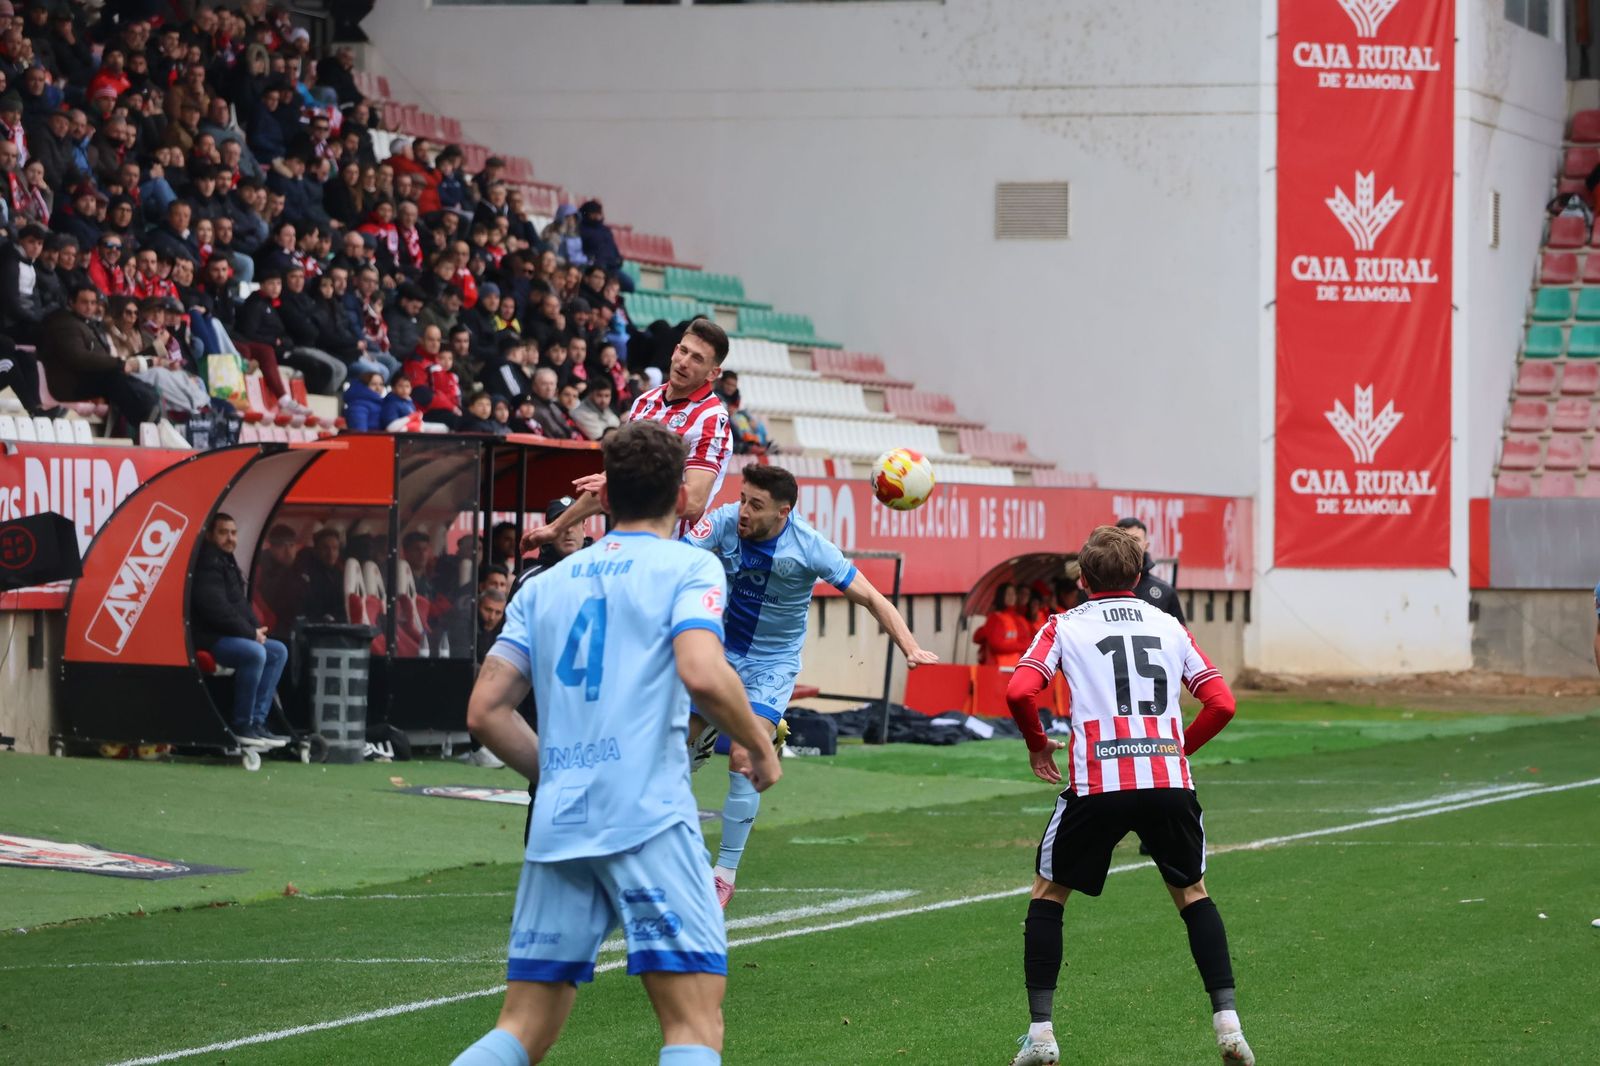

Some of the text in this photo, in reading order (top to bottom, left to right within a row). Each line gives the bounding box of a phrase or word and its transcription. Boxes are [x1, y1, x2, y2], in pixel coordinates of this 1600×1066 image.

[1293, 42, 1440, 71] CAJA RURAL
[1318, 72, 1414, 90] DE ZAMORA
[1291, 255, 1438, 283] CAJA RURAL
[1316, 285, 1411, 302] DE ZAMORA
[1290, 469, 1437, 495] CAJA RURAL
[871, 487, 1046, 540] FABRICACIÓN DE STAND
[1316, 498, 1411, 515] DE ZAMORA
[104, 519, 181, 649] AMAQ
[1103, 607, 1143, 622] LOREN
[555, 596, 607, 702] 4
[1095, 635, 1168, 716] 15
[1096, 741, 1179, 756] leomotor.net
